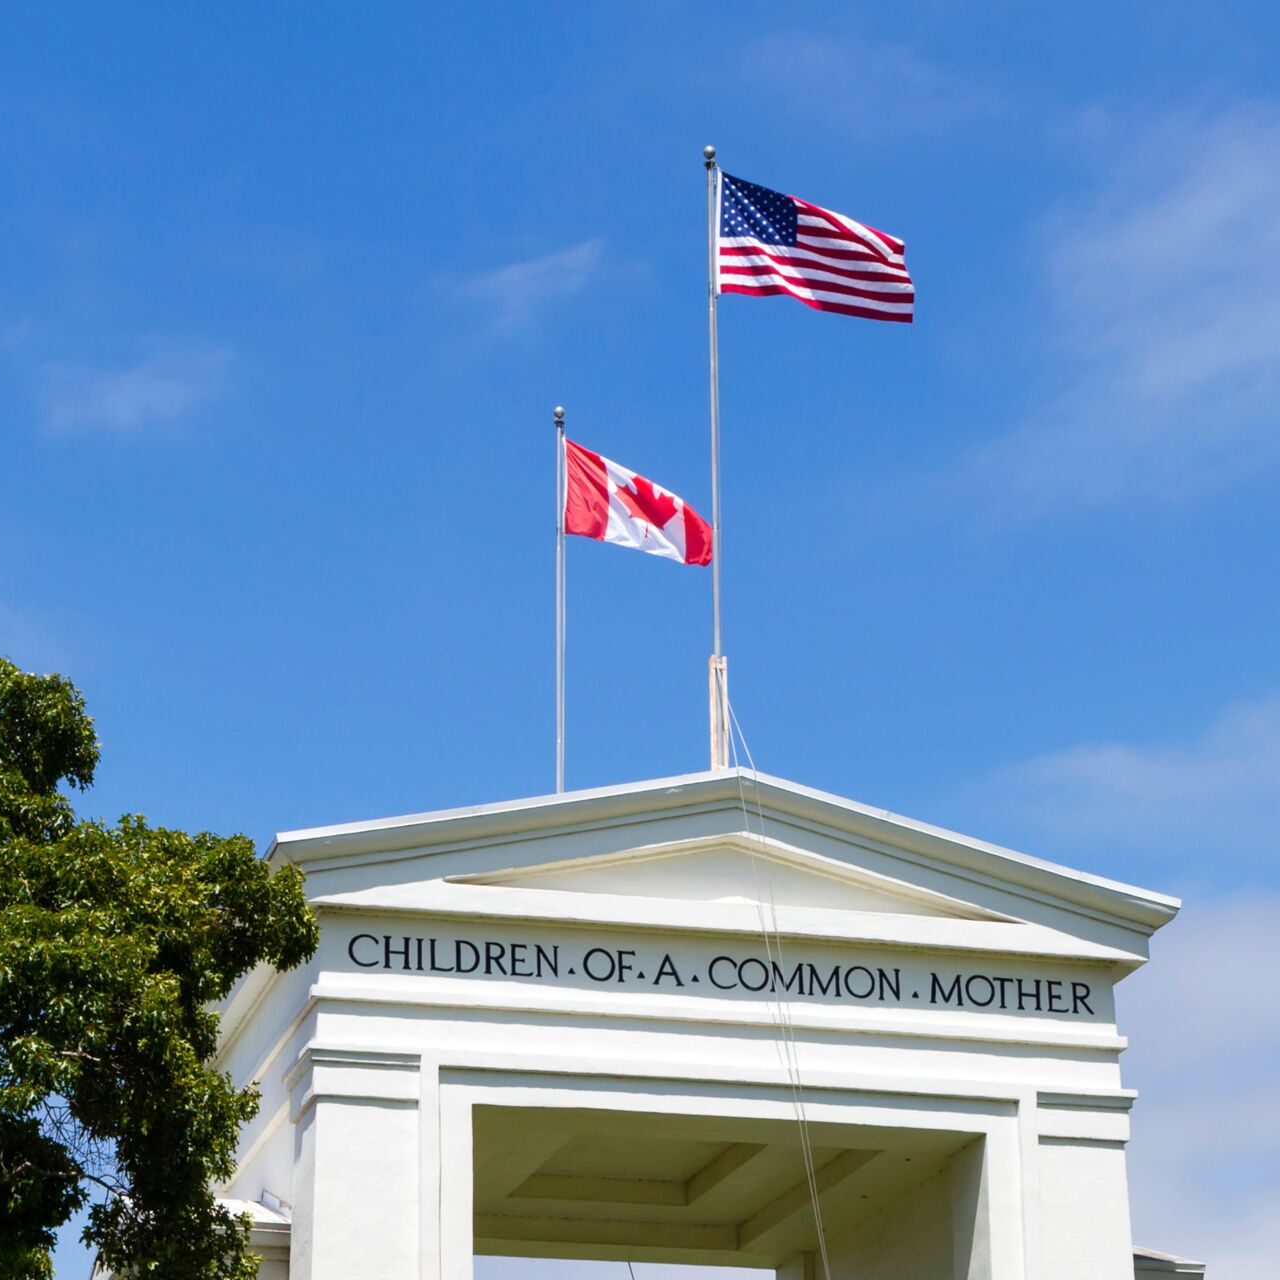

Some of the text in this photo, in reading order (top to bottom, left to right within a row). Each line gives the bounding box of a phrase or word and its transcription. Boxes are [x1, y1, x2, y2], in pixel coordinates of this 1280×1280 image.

[346, 932, 1096, 1015] CHILDREN OF A COMMON MOTHER
